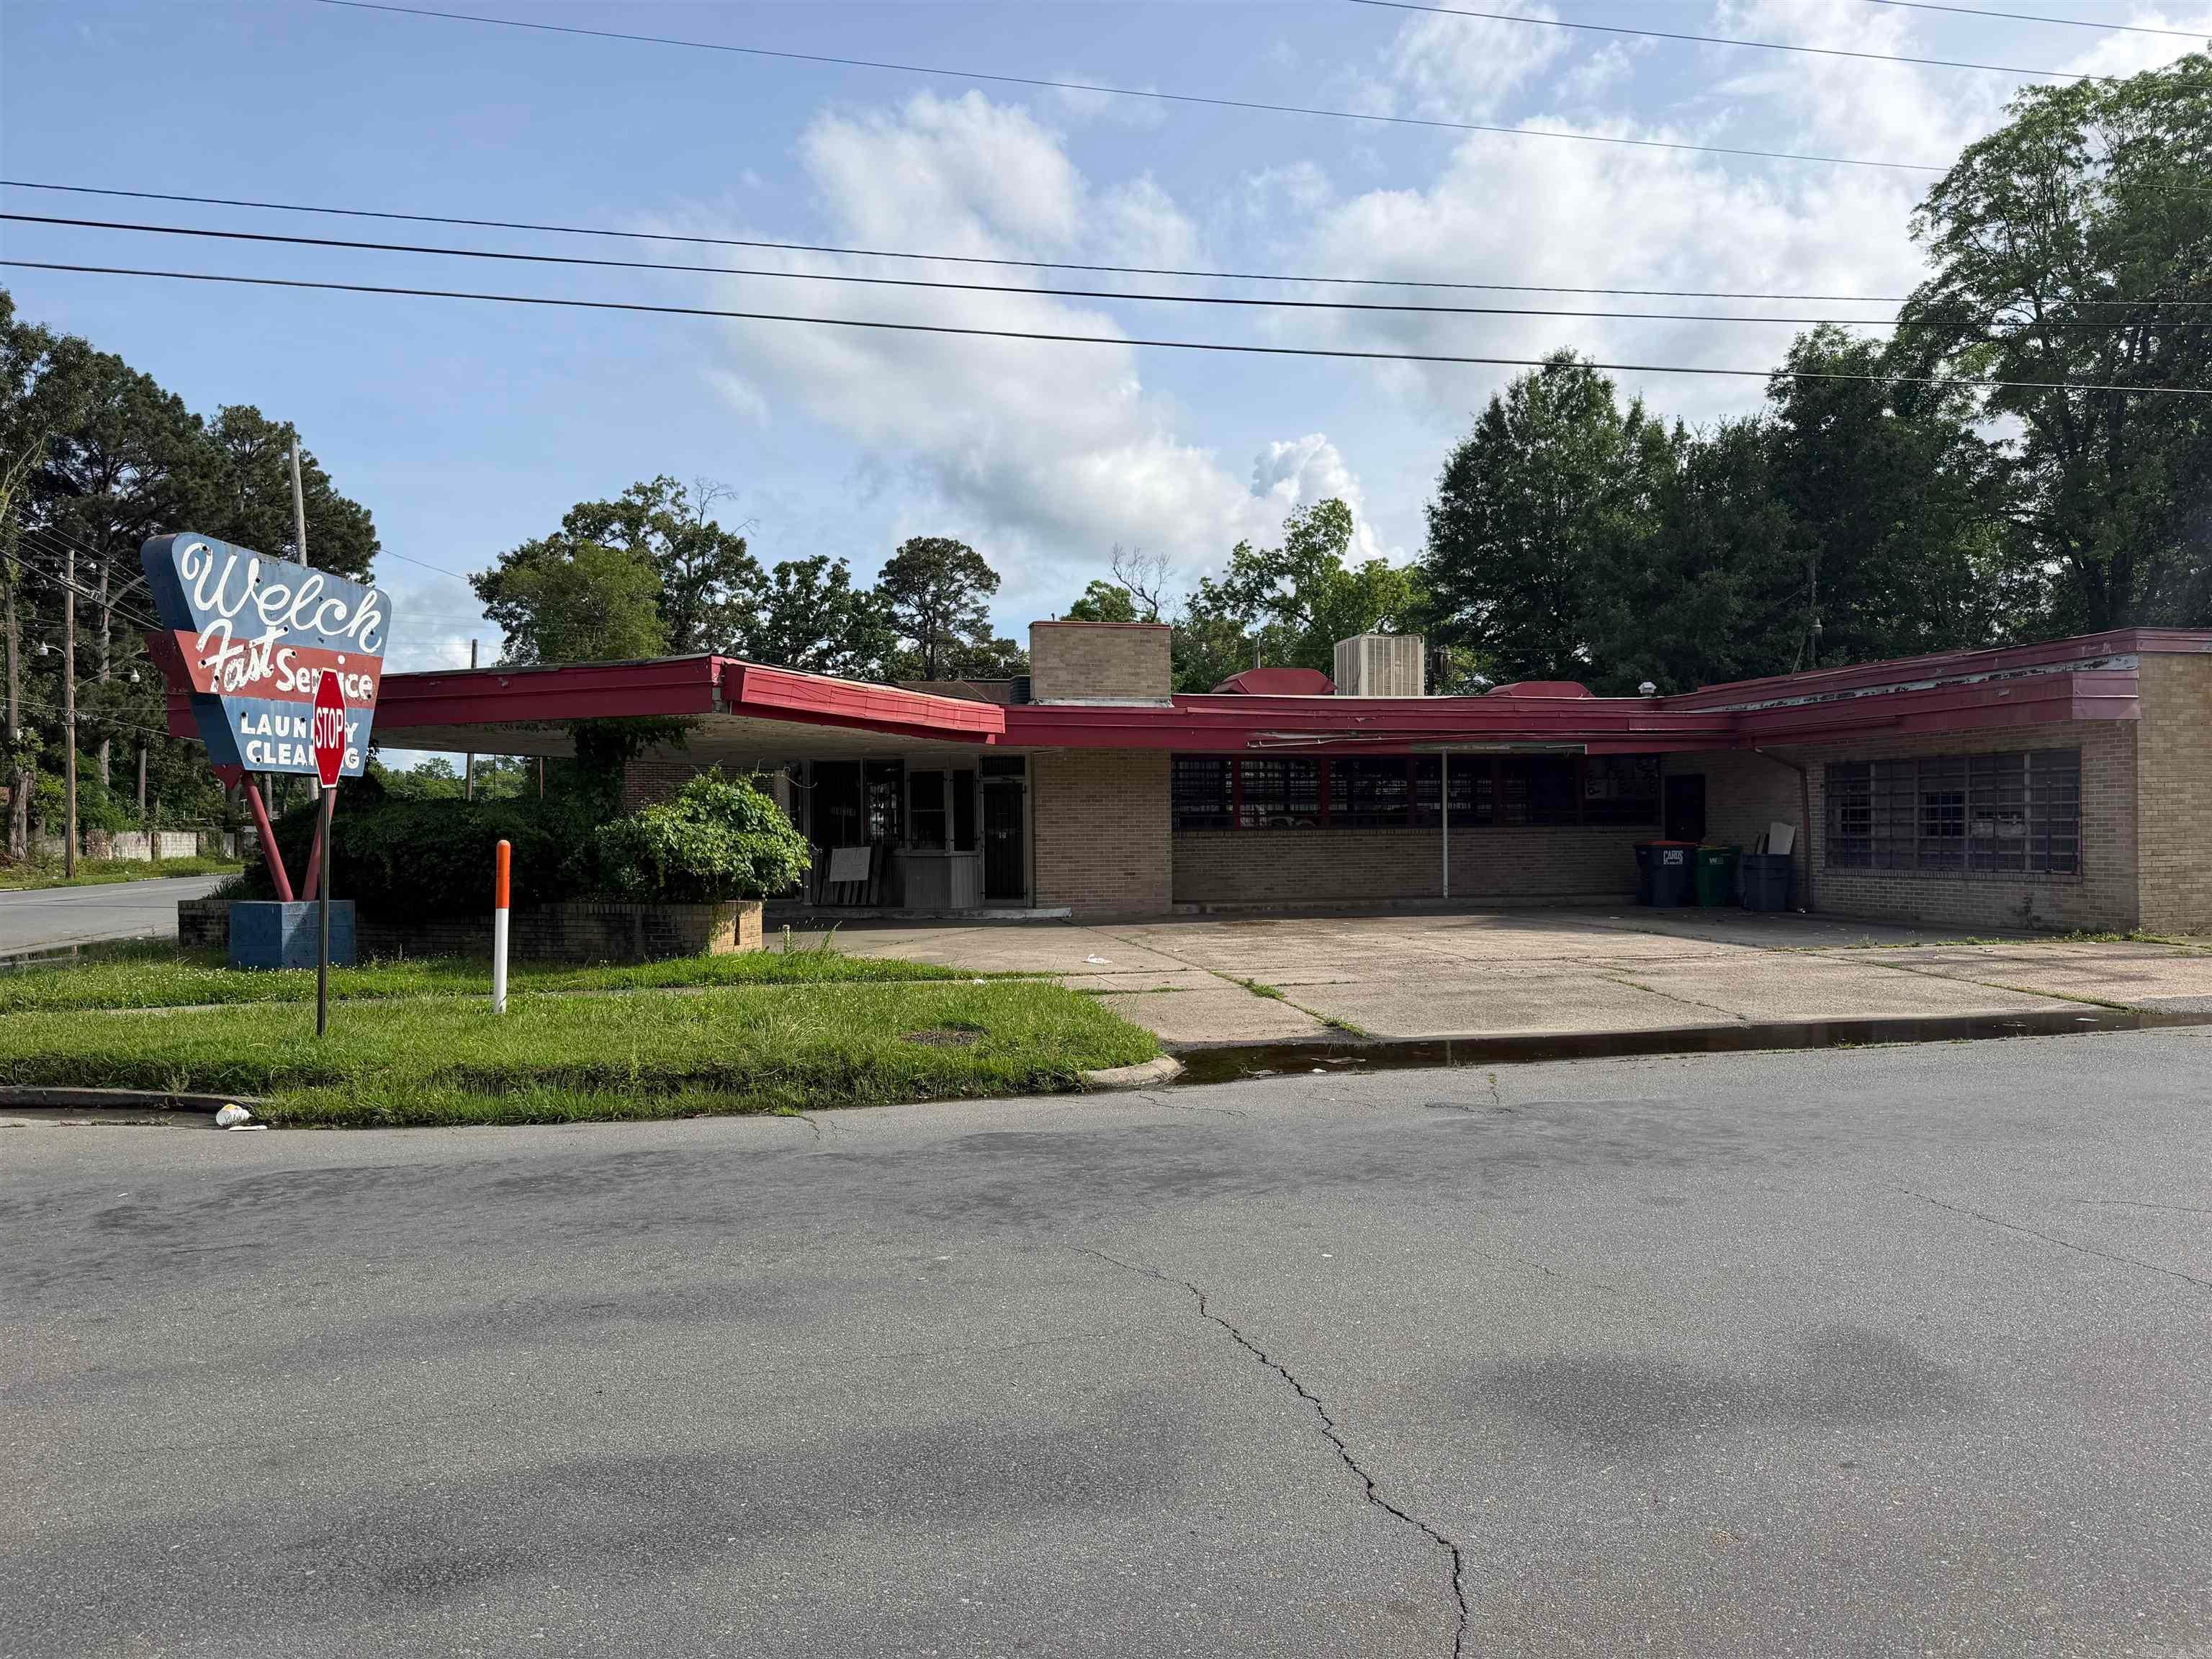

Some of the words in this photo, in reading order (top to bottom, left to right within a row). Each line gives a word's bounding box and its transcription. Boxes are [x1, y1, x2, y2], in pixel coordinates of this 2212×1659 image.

[182, 542, 382, 652] Welch
[196, 619, 288, 692] Fast
[276, 648, 373, 699] Serice
[241, 712, 359, 742] LAUNY
[316, 706, 343, 749] STOP
[246, 739, 359, 769] CLEAG
